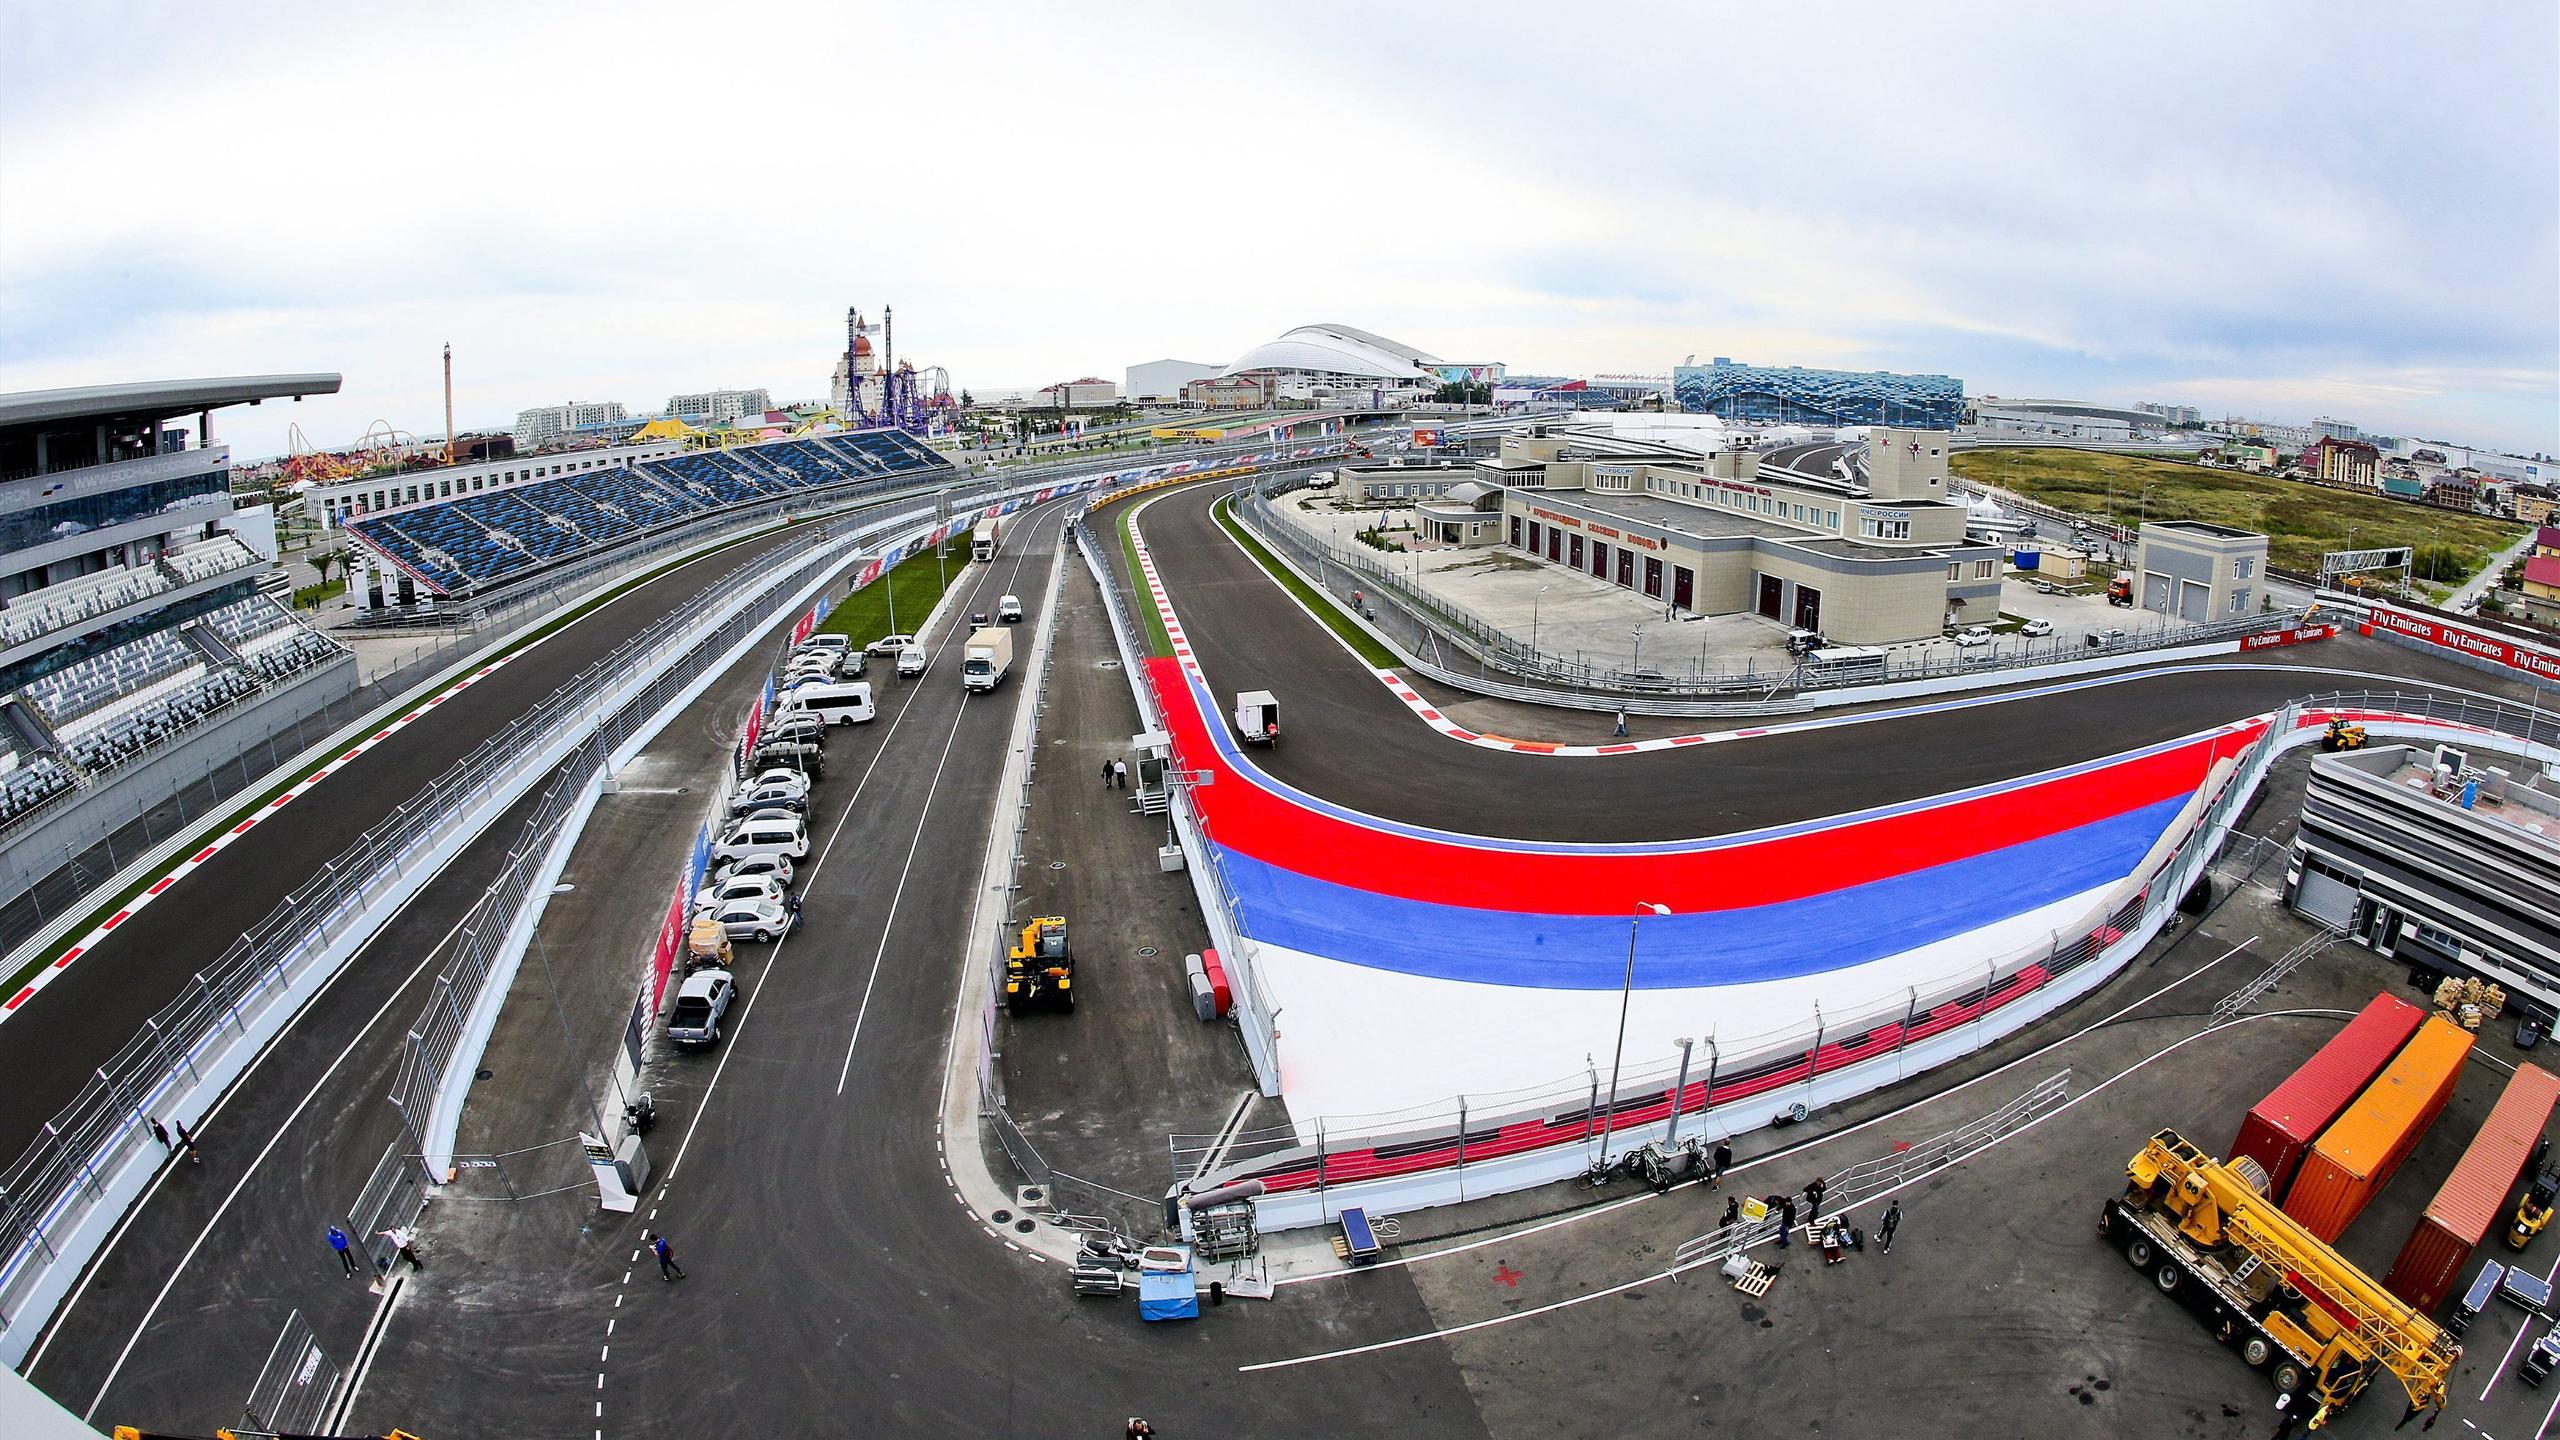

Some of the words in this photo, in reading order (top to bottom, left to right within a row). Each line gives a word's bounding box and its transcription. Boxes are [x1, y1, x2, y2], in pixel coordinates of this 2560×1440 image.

[1877, 510, 1909, 518] РОССИИ
[382, 573, 395, 584] T1
[2373, 609, 2389, 627] Fly
[2390, 614, 2432, 636] Emirates
[2294, 630, 2303, 640] Fly
[2303, 628, 2323, 638] Emirates
[2248, 637, 2258, 647] Fly
[2258, 635, 2281, 645] Emirates
[2443, 629, 2460, 647] Fly
[2460, 634, 2503, 657] Emirates
[2513, 650, 2531, 669] Fly
